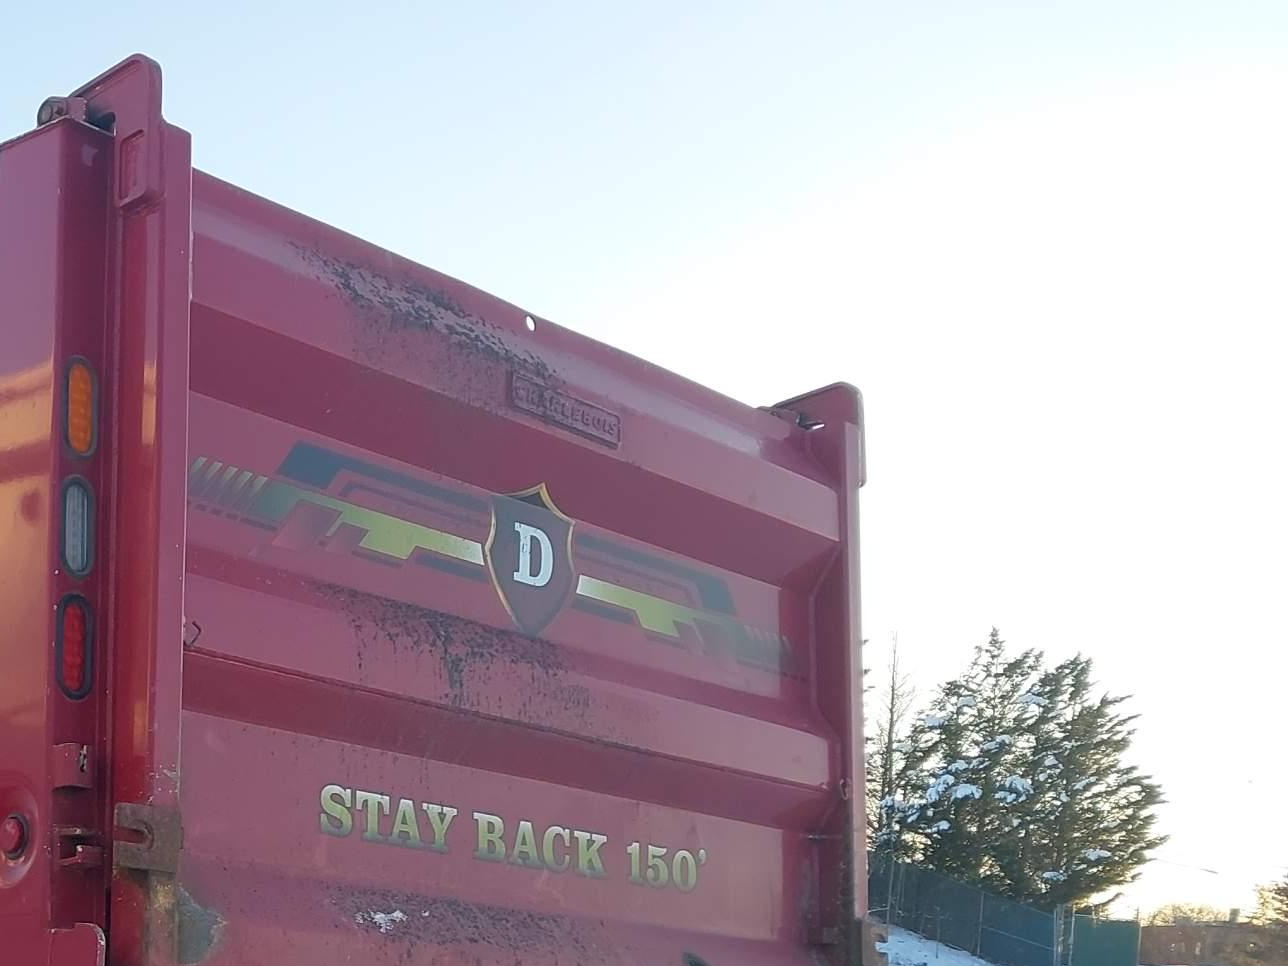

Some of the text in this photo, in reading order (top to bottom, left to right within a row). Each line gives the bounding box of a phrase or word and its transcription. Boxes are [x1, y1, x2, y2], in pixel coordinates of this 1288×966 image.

[512, 521, 554, 588] D
[319, 783, 458, 853] STAY
[471, 811, 609, 878] BACK
